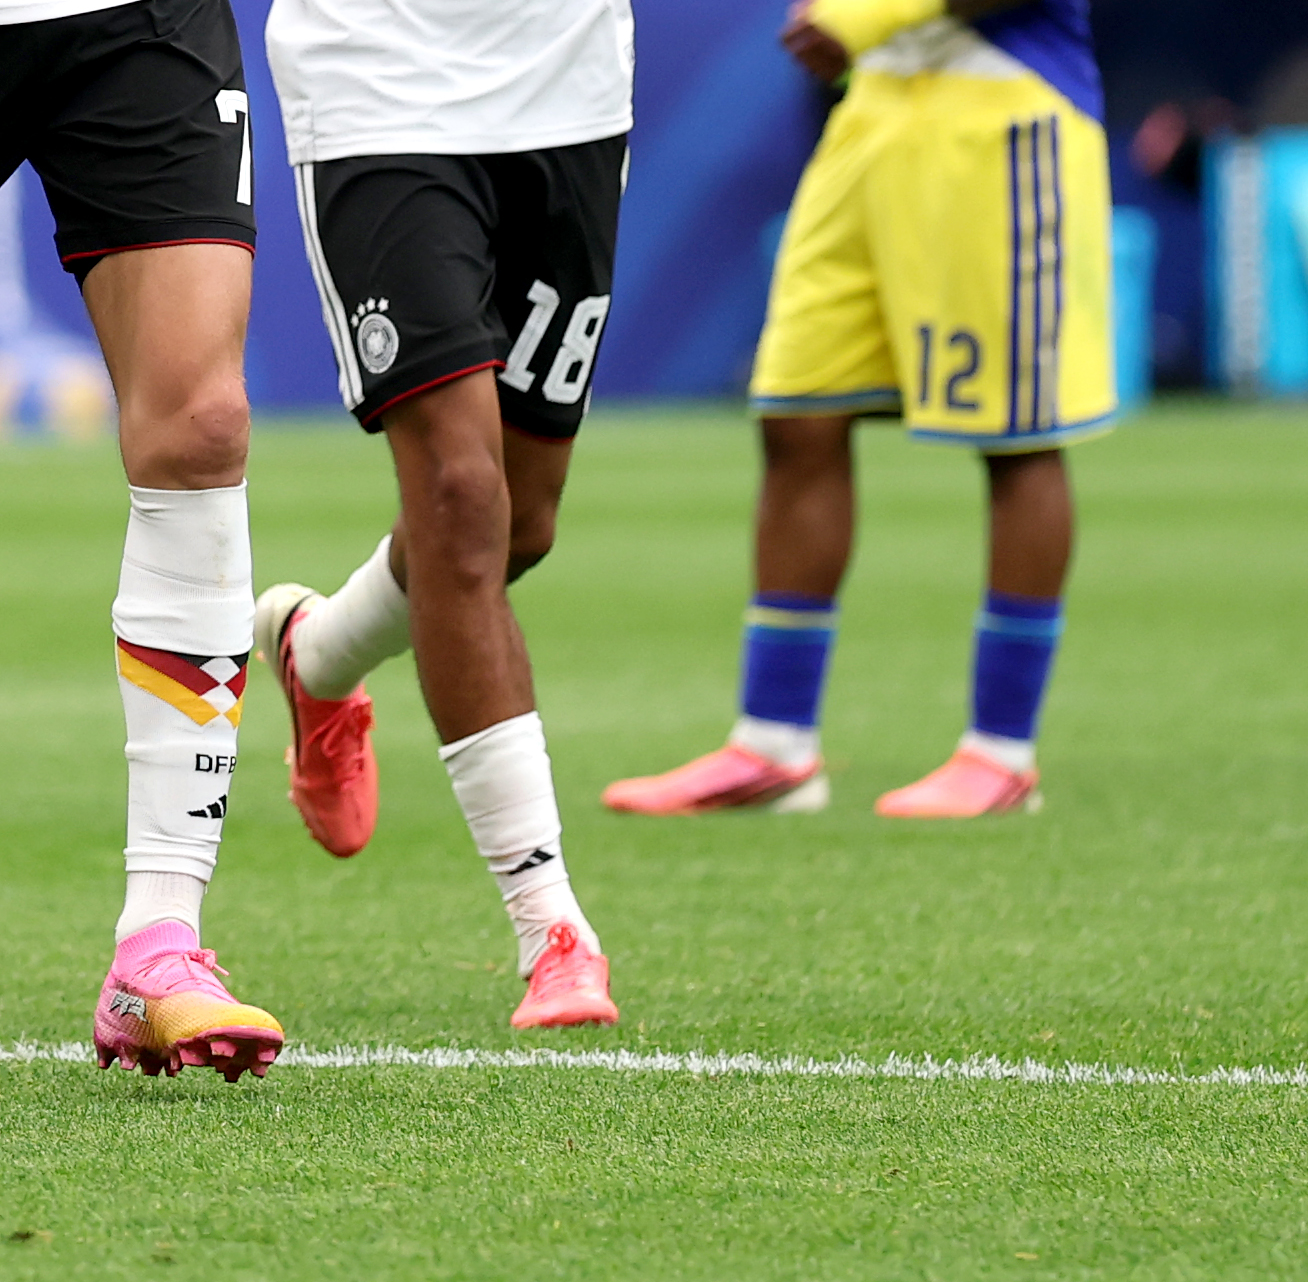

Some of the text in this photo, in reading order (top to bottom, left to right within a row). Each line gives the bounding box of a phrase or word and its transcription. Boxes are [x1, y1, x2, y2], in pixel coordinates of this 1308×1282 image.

[215, 89, 251, 206] 7
[498, 279, 611, 404] 18
[917, 324, 980, 411] 12
[195, 753, 236, 774] DFB
